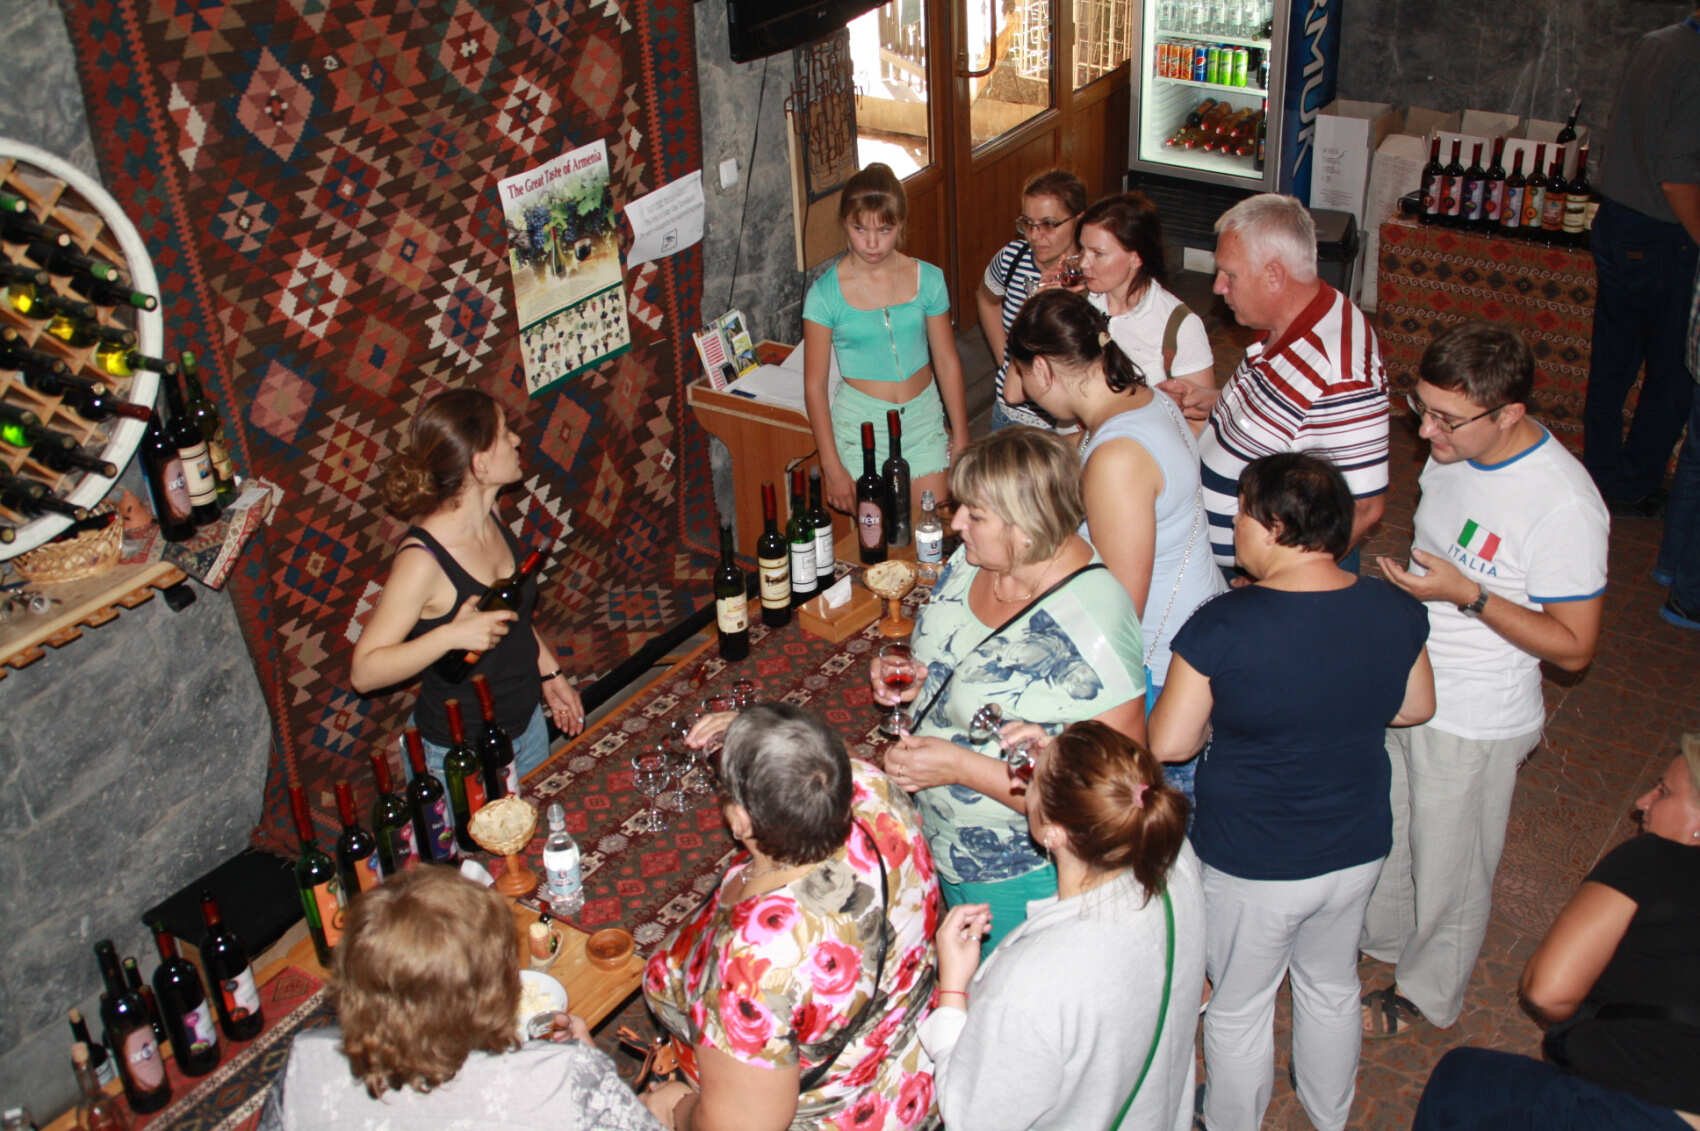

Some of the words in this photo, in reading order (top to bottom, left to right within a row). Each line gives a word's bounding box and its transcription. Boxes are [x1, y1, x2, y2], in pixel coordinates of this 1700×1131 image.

[507, 183, 524, 199] The
[525, 176, 545, 192] Great
[544, 167, 562, 184] Taste
[563, 160, 571, 175] of
[572, 148, 602, 171] Armenia
[1447, 543, 1497, 577] ITALIA
